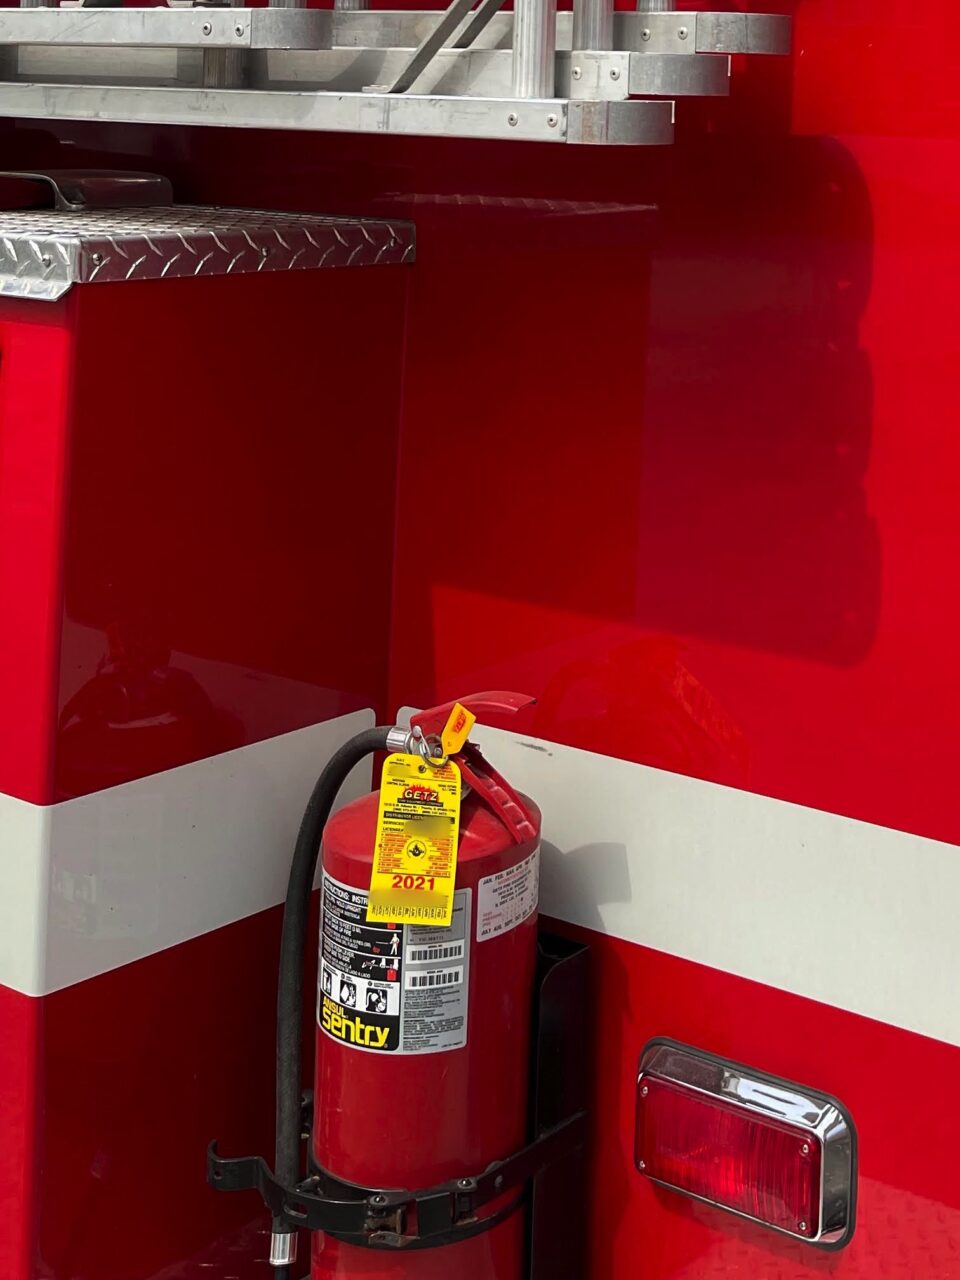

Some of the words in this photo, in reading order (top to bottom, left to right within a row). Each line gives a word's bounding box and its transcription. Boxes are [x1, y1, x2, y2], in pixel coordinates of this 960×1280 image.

[404, 789, 439, 801] GETZ
[391, 874, 435, 891] 2021
[323, 995, 346, 1019] ANSUL
[322, 1006, 390, 1048] sentry
